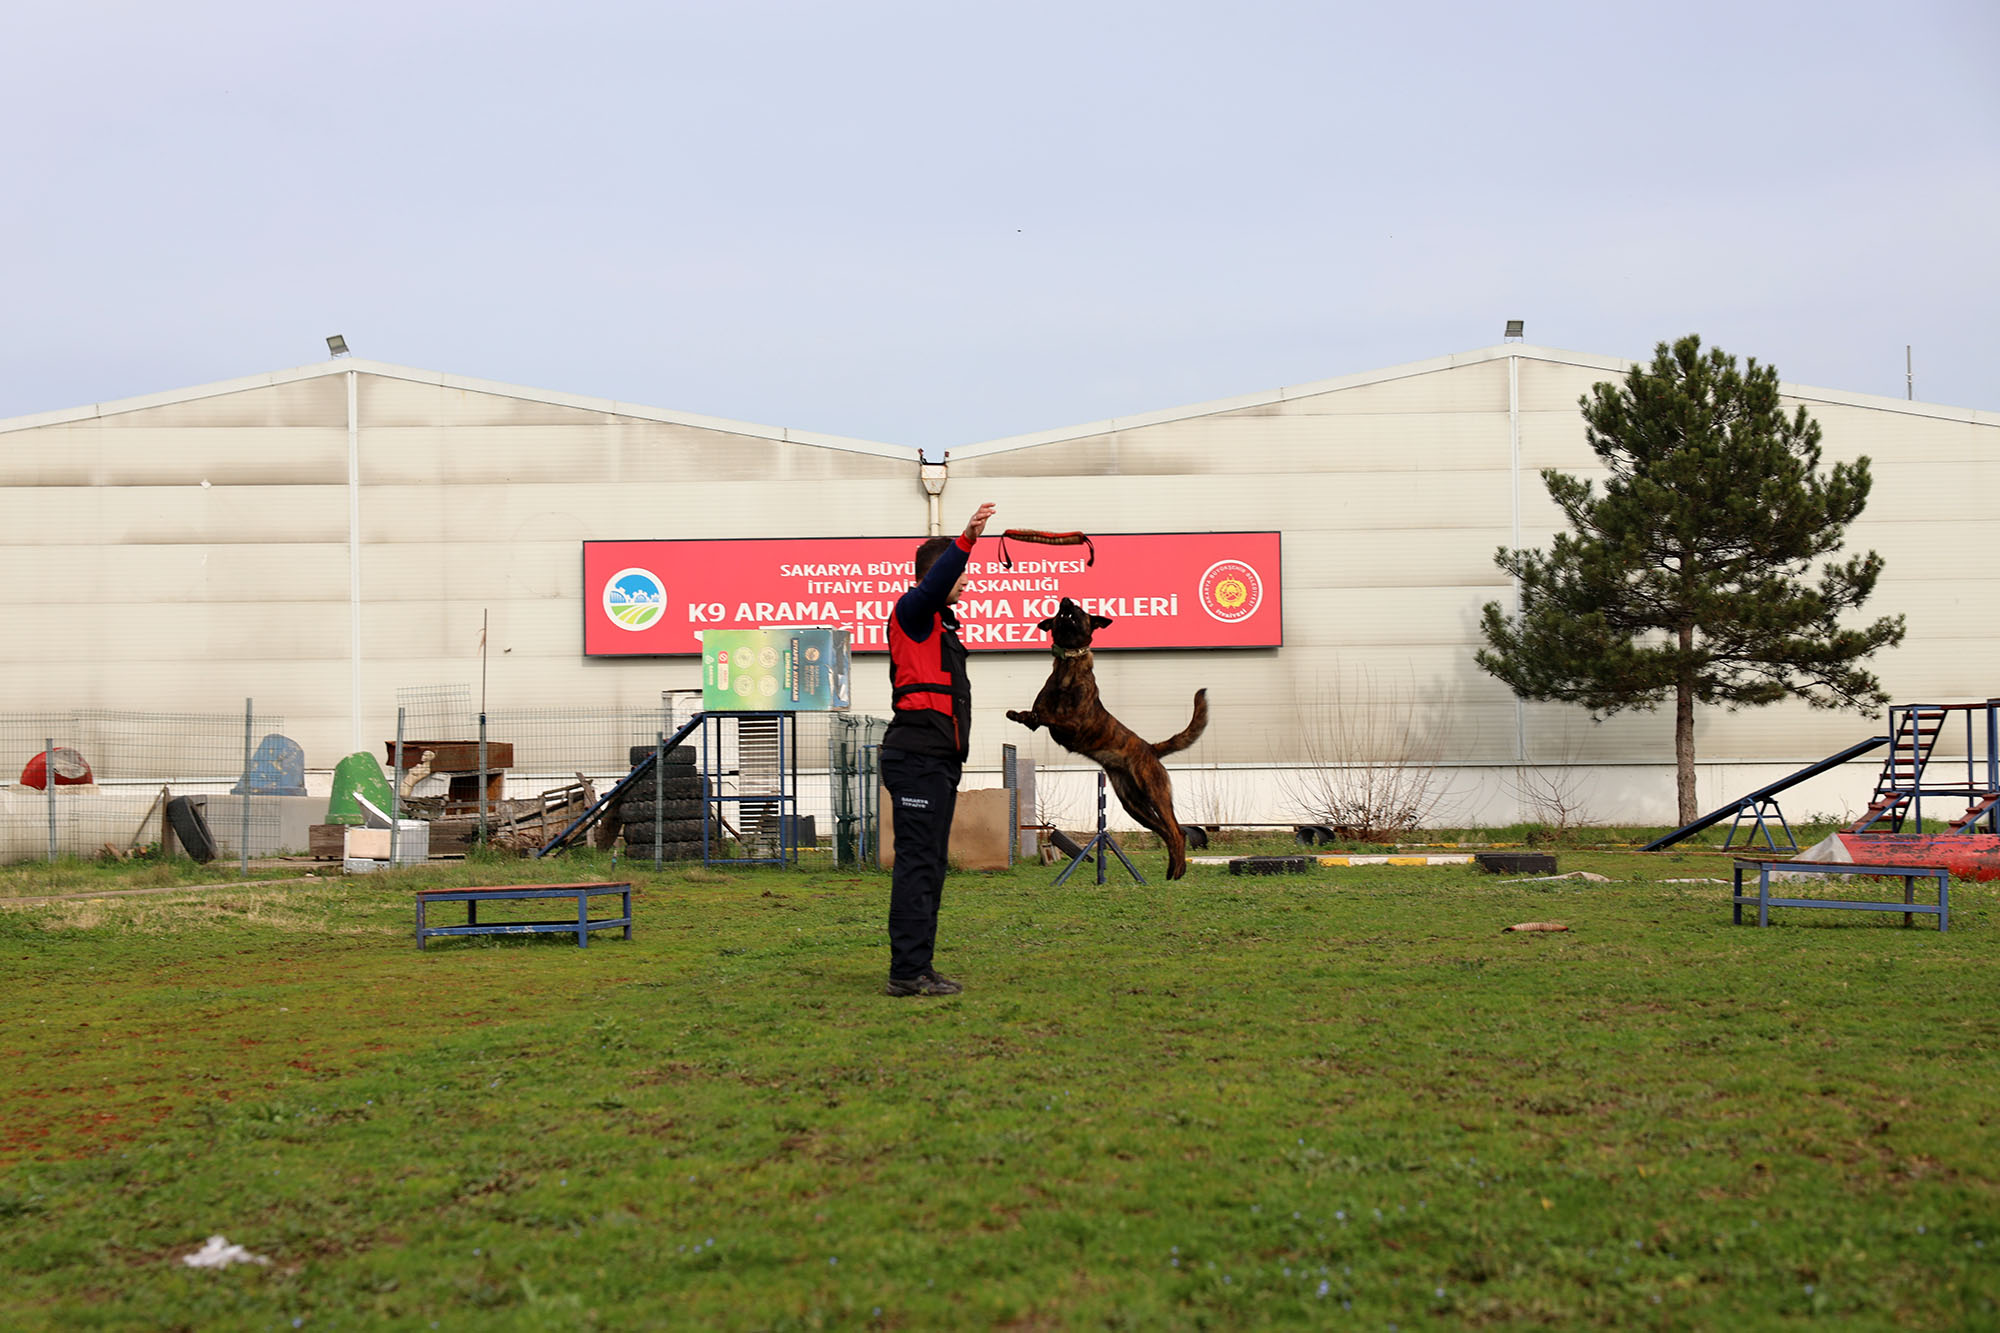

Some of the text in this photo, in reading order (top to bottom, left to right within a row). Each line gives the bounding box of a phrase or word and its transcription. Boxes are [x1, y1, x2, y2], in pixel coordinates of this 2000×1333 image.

[780, 563, 863, 577] SAKARYA
[986, 558, 1085, 575] BELEDİYESİ
[807, 579, 873, 594] İTFAİYE
[961, 577, 1059, 594] AŞKANLIĞI
[688, 602, 726, 622] K9
[734, 598, 1015, 622] ARAMA-KURMA
[955, 620, 1048, 644] ERKEZİ
